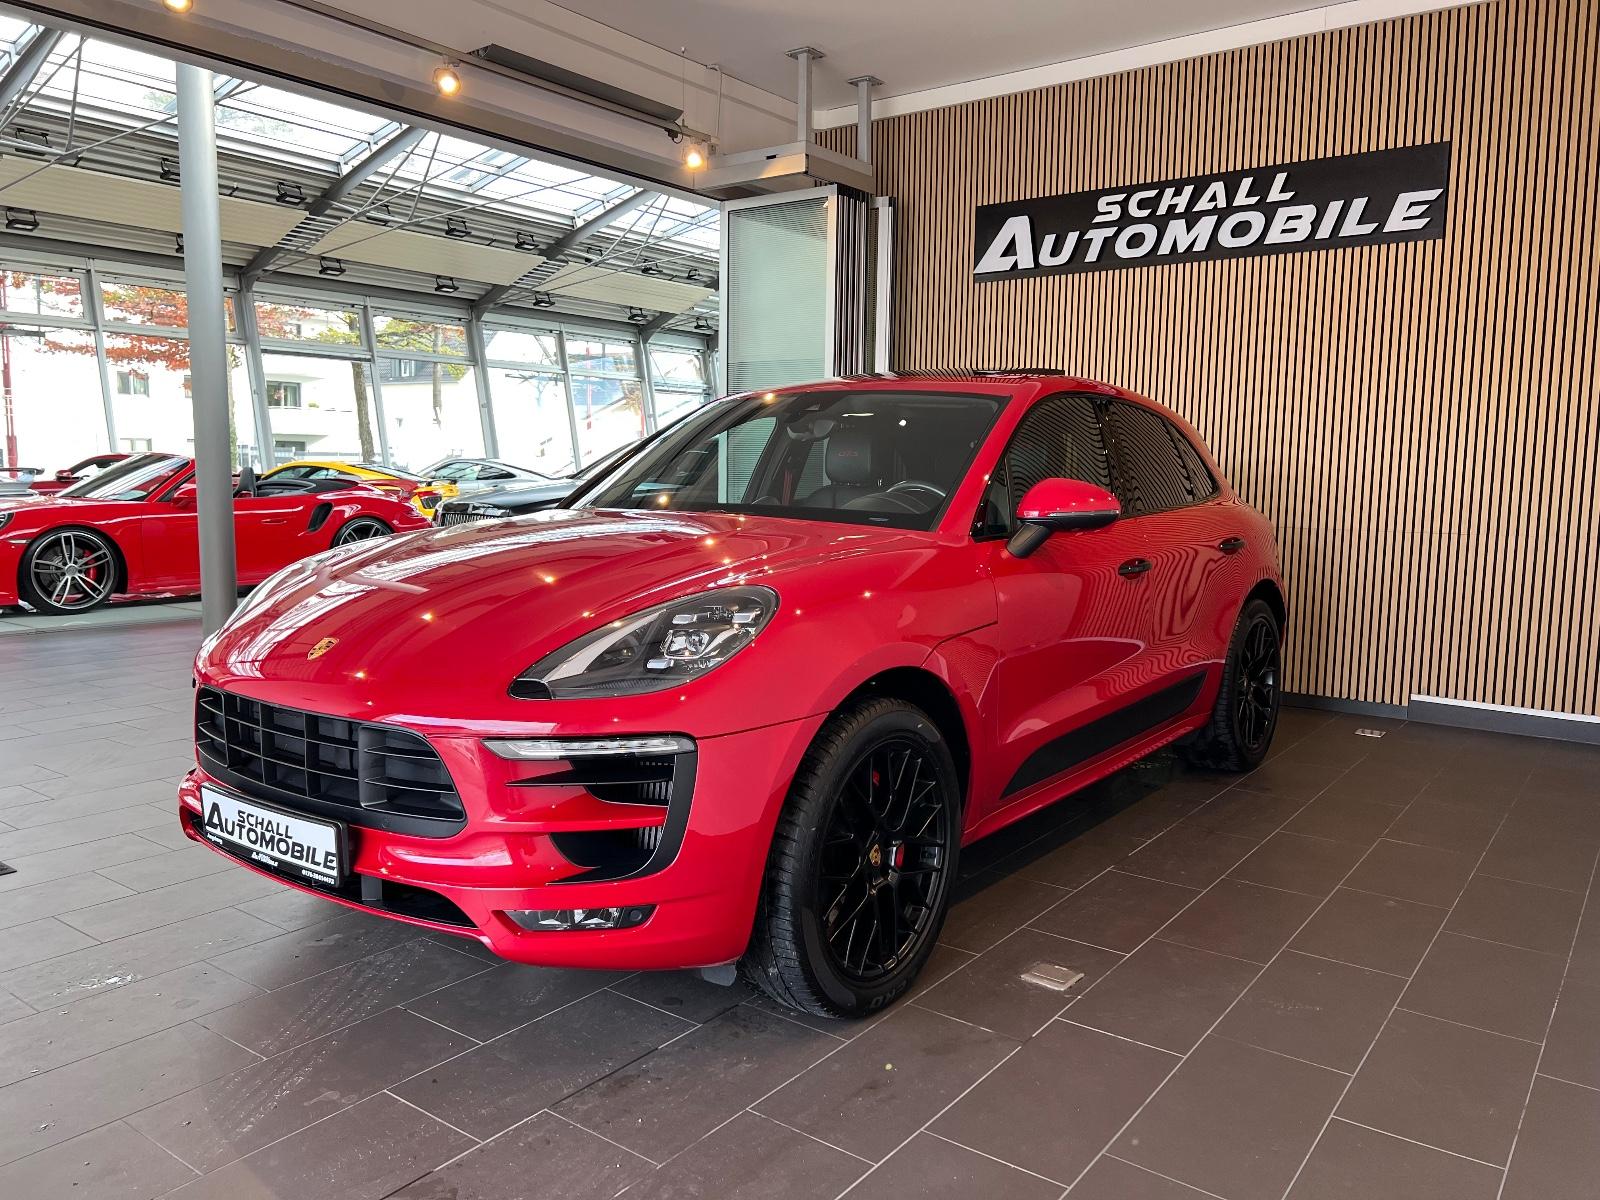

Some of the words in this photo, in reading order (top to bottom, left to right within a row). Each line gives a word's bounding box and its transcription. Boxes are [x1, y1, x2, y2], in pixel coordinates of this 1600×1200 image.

[1093, 171, 1296, 223] SCHALL
[974, 188, 1444, 275] AUTOMOBILE
[206, 802, 337, 870] AUTOMOBILE
[237, 810, 293, 840] SCHALL
